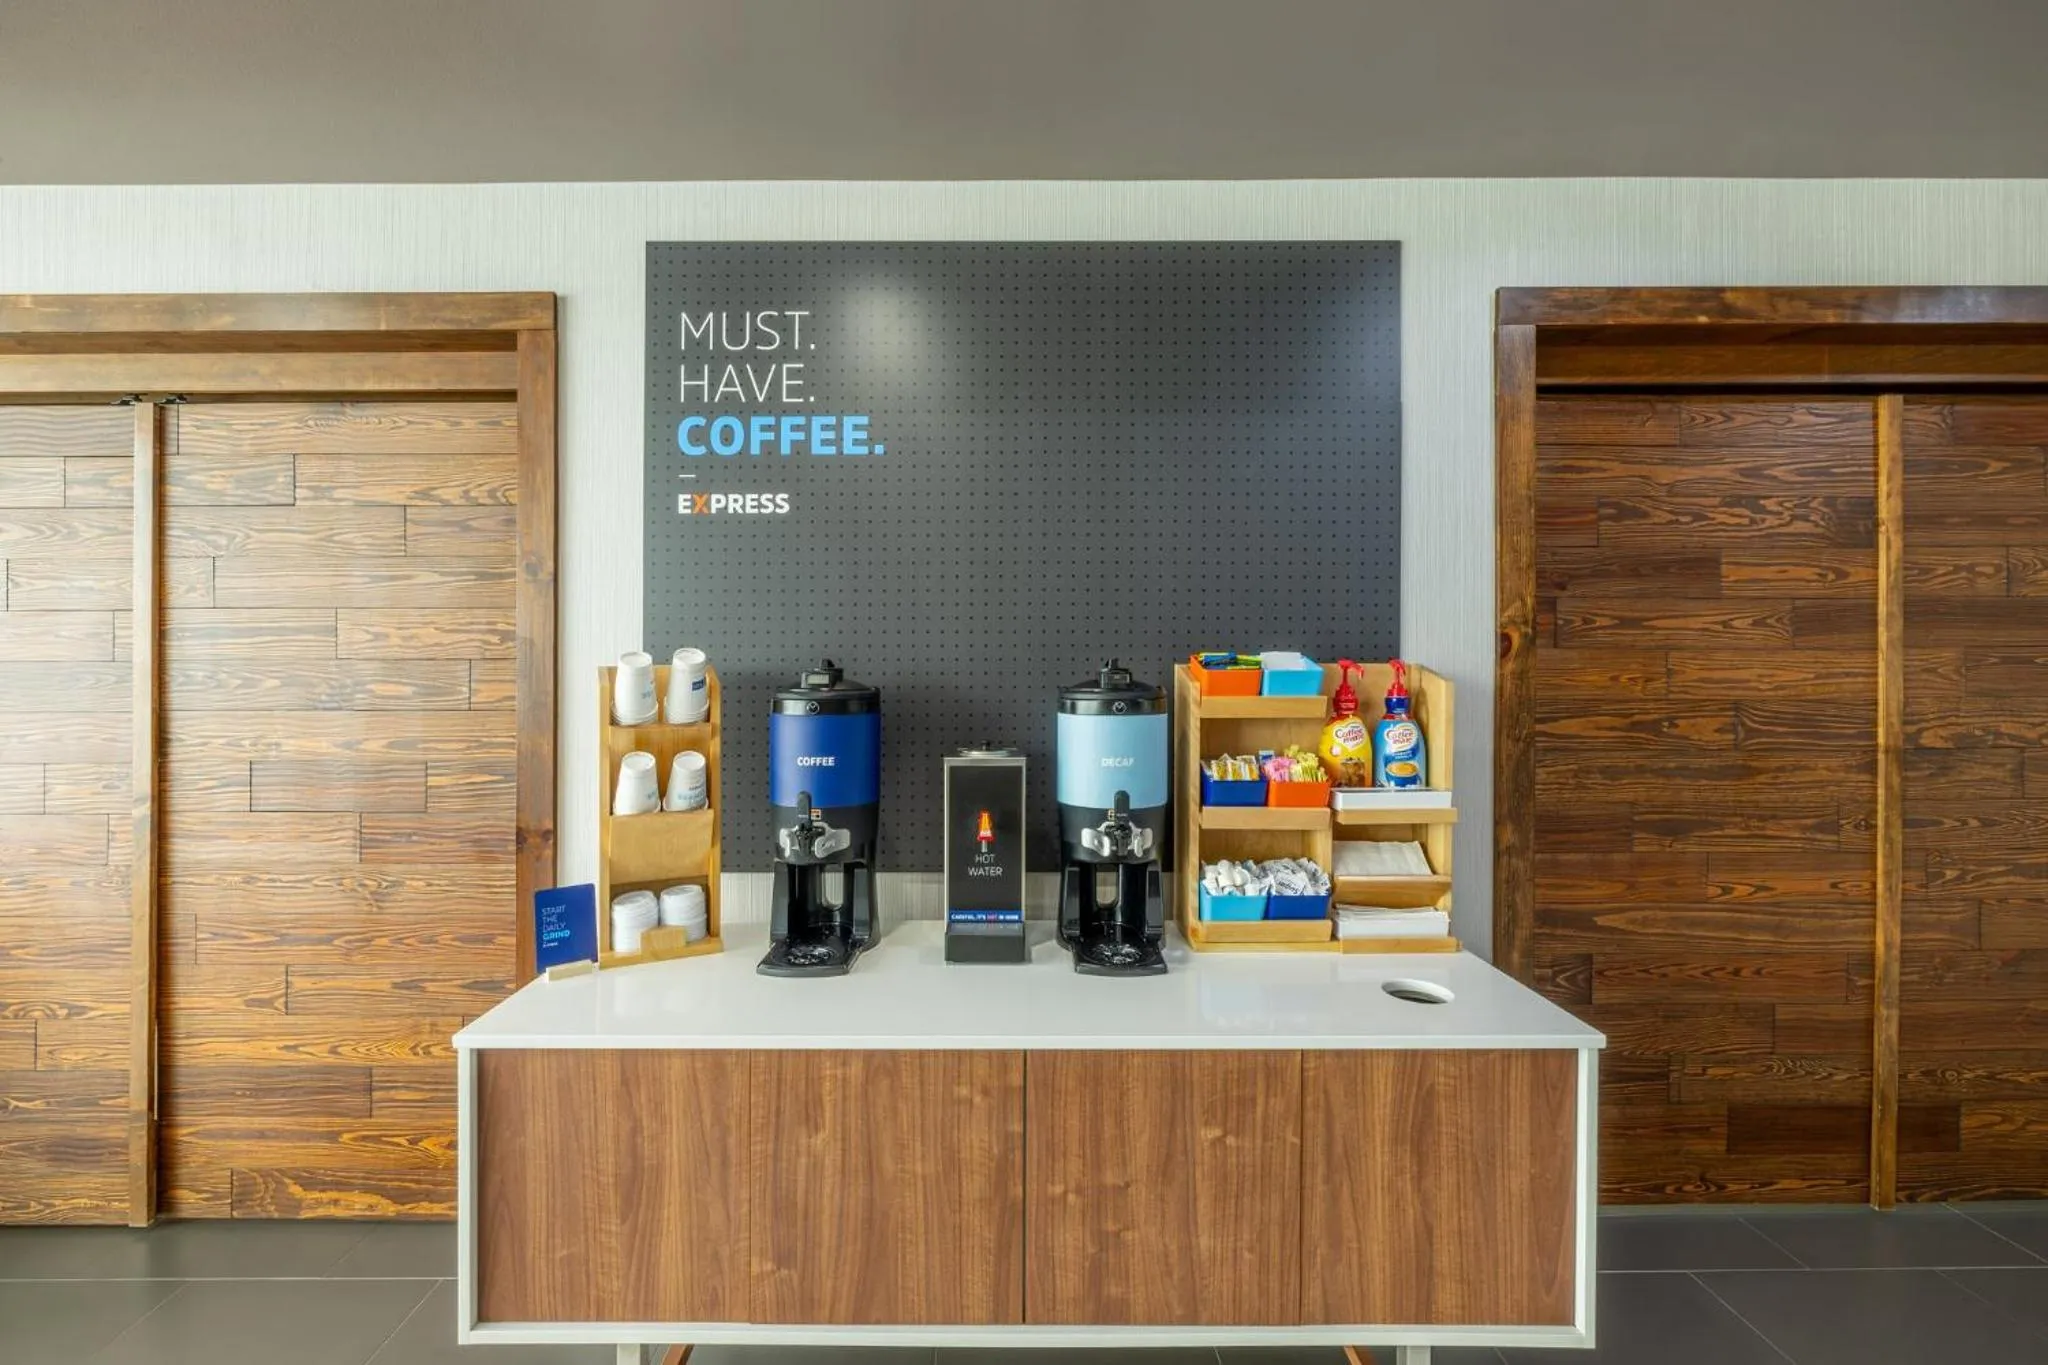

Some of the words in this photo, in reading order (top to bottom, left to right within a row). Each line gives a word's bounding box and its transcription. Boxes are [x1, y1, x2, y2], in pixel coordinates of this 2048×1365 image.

[680, 311, 816, 351] MUST.
[680, 363, 815, 403] HAVE.
[677, 415, 885, 456] COFFEE.
[677, 493, 790, 514] EXPRESS
[797, 756, 836, 767] COFFEE
[1101, 757, 1133, 768] DECAF
[974, 854, 995, 864] HOT
[967, 866, 1004, 877] WATER
[542, 905, 566, 915] START
[542, 915, 558, 924] THE
[543, 922, 566, 932] DAILY
[543, 930, 570, 940] GRIND
